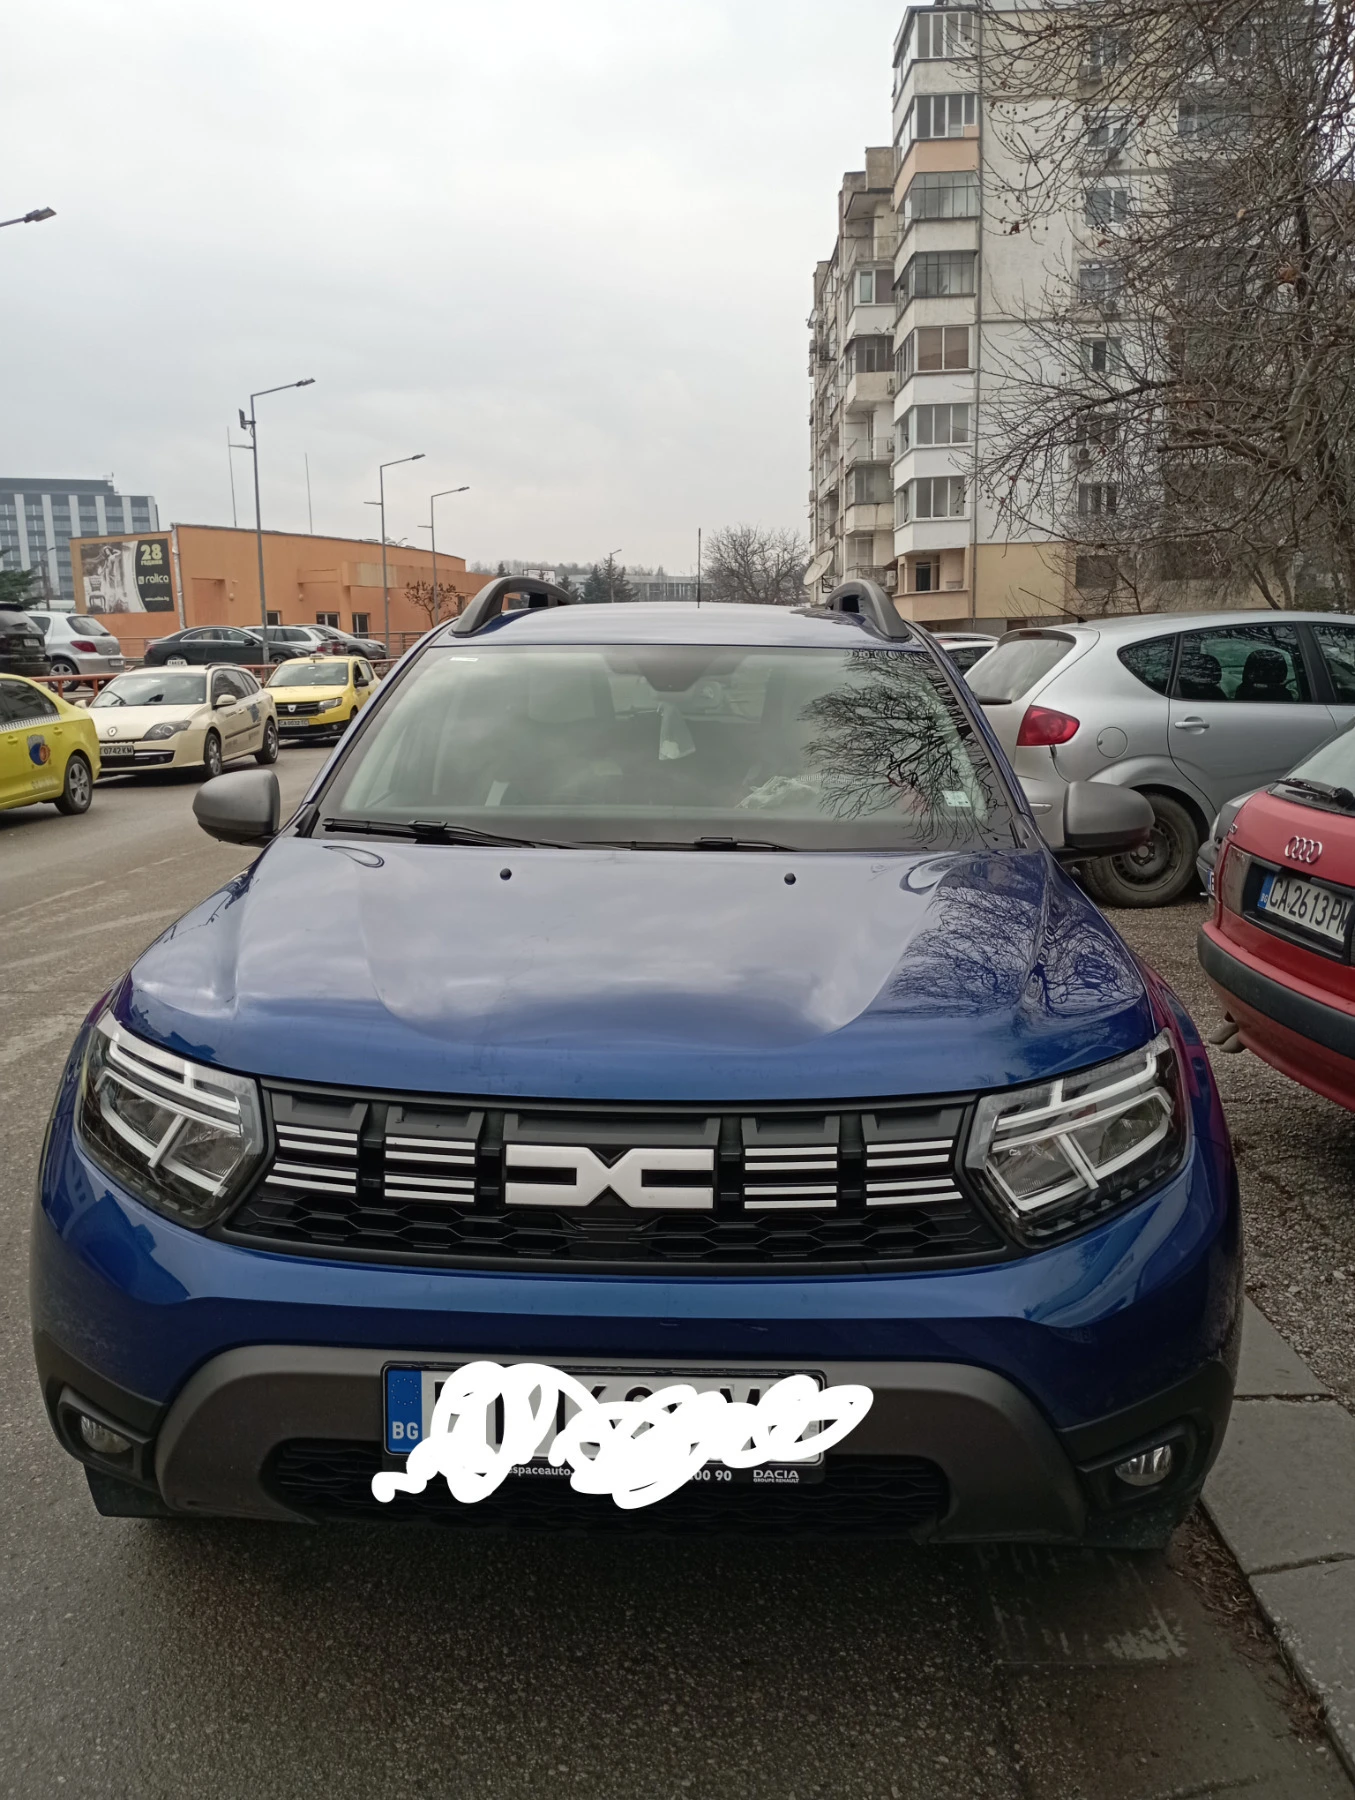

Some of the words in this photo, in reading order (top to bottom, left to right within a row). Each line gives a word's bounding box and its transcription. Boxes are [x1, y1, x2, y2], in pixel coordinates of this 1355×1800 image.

[140, 543, 163, 560] 28
[392, 1421, 419, 1440] BG
[715, 1470, 732, 1481] 90
[753, 1469, 800, 1479] DACIA
